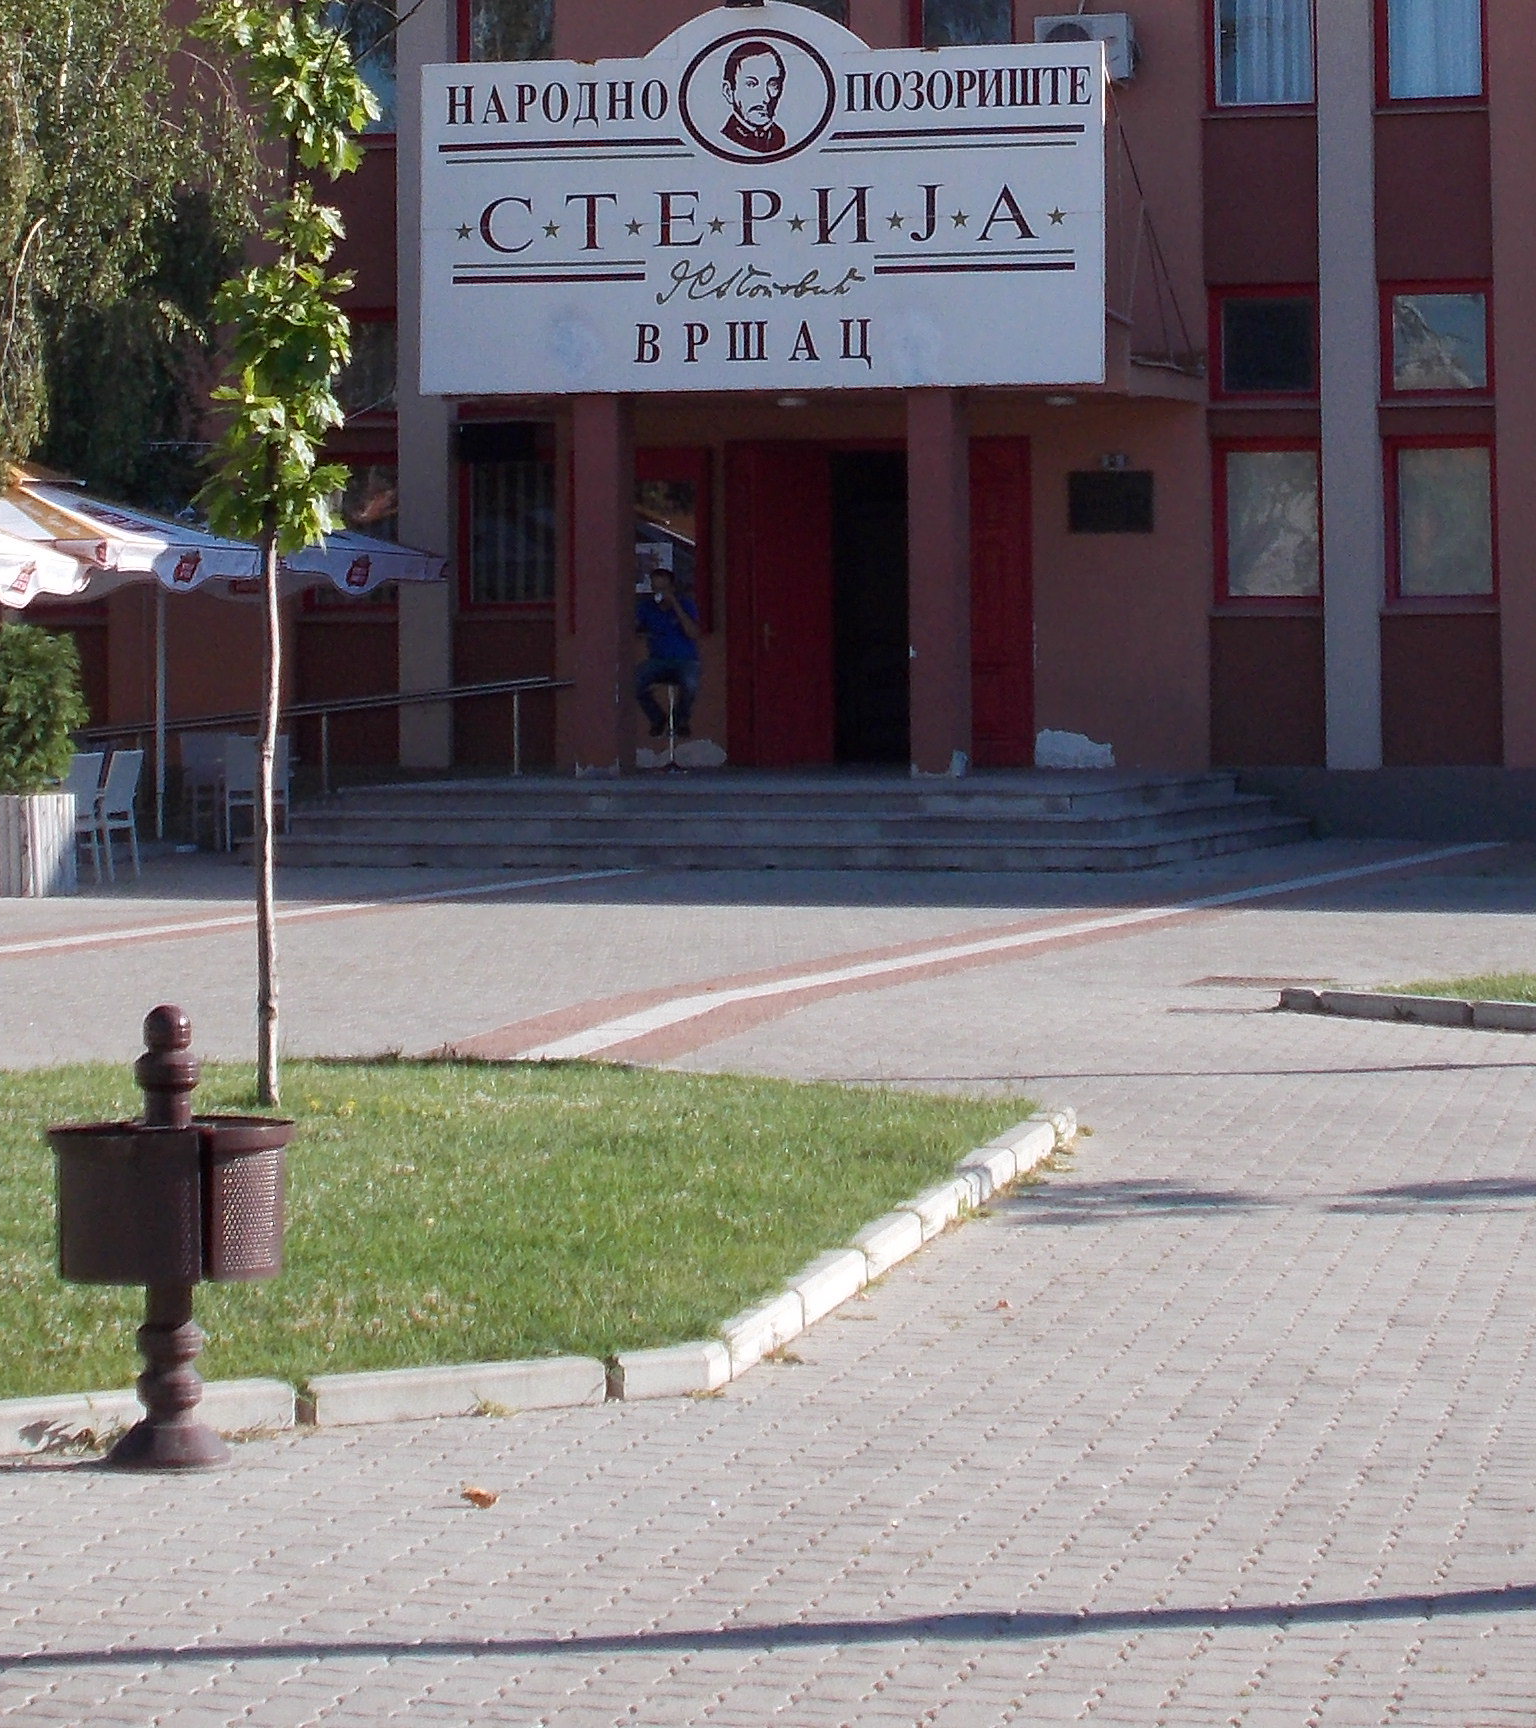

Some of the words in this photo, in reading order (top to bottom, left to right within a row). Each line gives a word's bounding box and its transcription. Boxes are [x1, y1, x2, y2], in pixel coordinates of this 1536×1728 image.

[446, 79, 669, 128] НАРОДНО
[844, 65, 1092, 113] ПОЗОРИШТЕ
[479, 183, 1040, 254] СТЕРИЈА
[632, 318, 872, 369] ВРШАЦ
